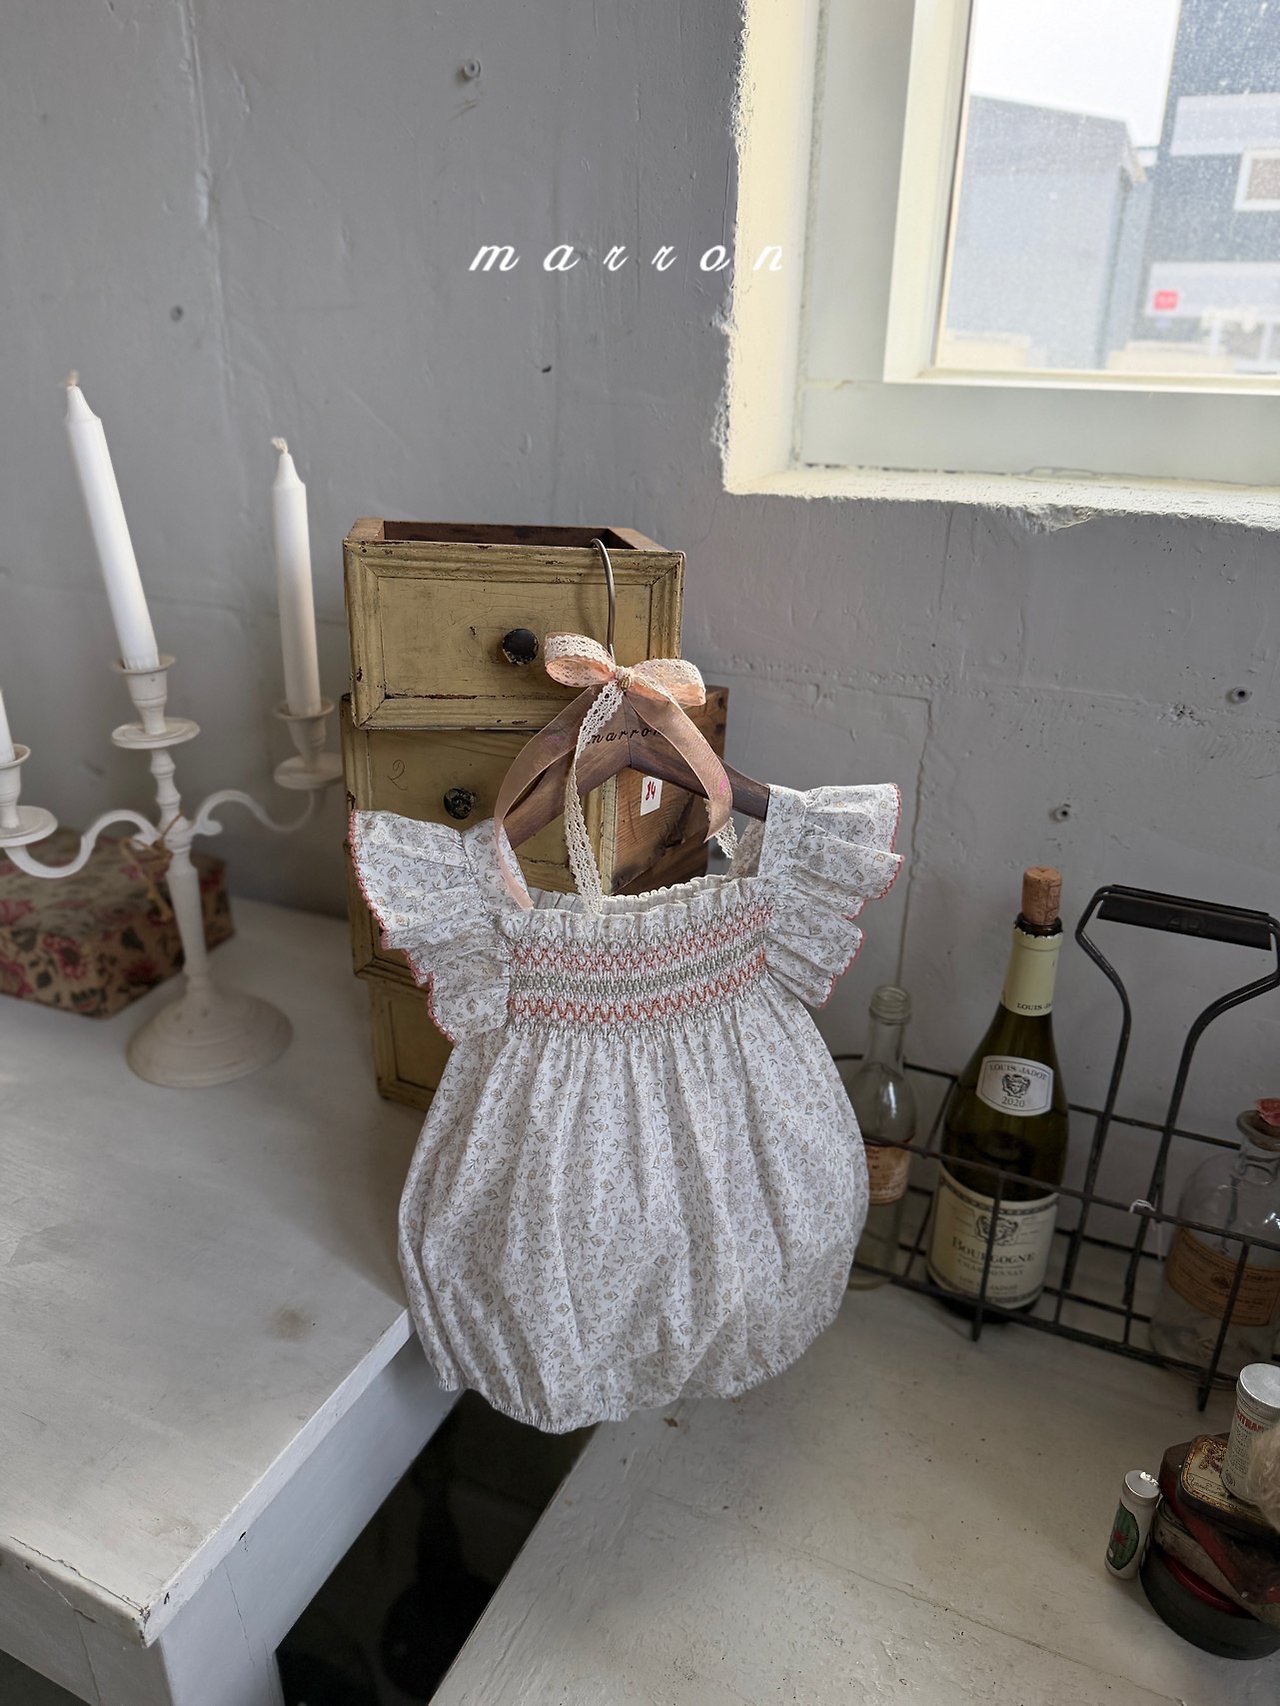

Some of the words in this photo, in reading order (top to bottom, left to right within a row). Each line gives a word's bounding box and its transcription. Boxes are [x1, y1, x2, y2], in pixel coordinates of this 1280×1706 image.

[1016, 1002, 1043, 1011] LOUIS
[989, 1063, 1017, 1072] LOUIS
[1019, 1066, 1048, 1081] JADOT
[1001, 1096, 1026, 1109] 2020
